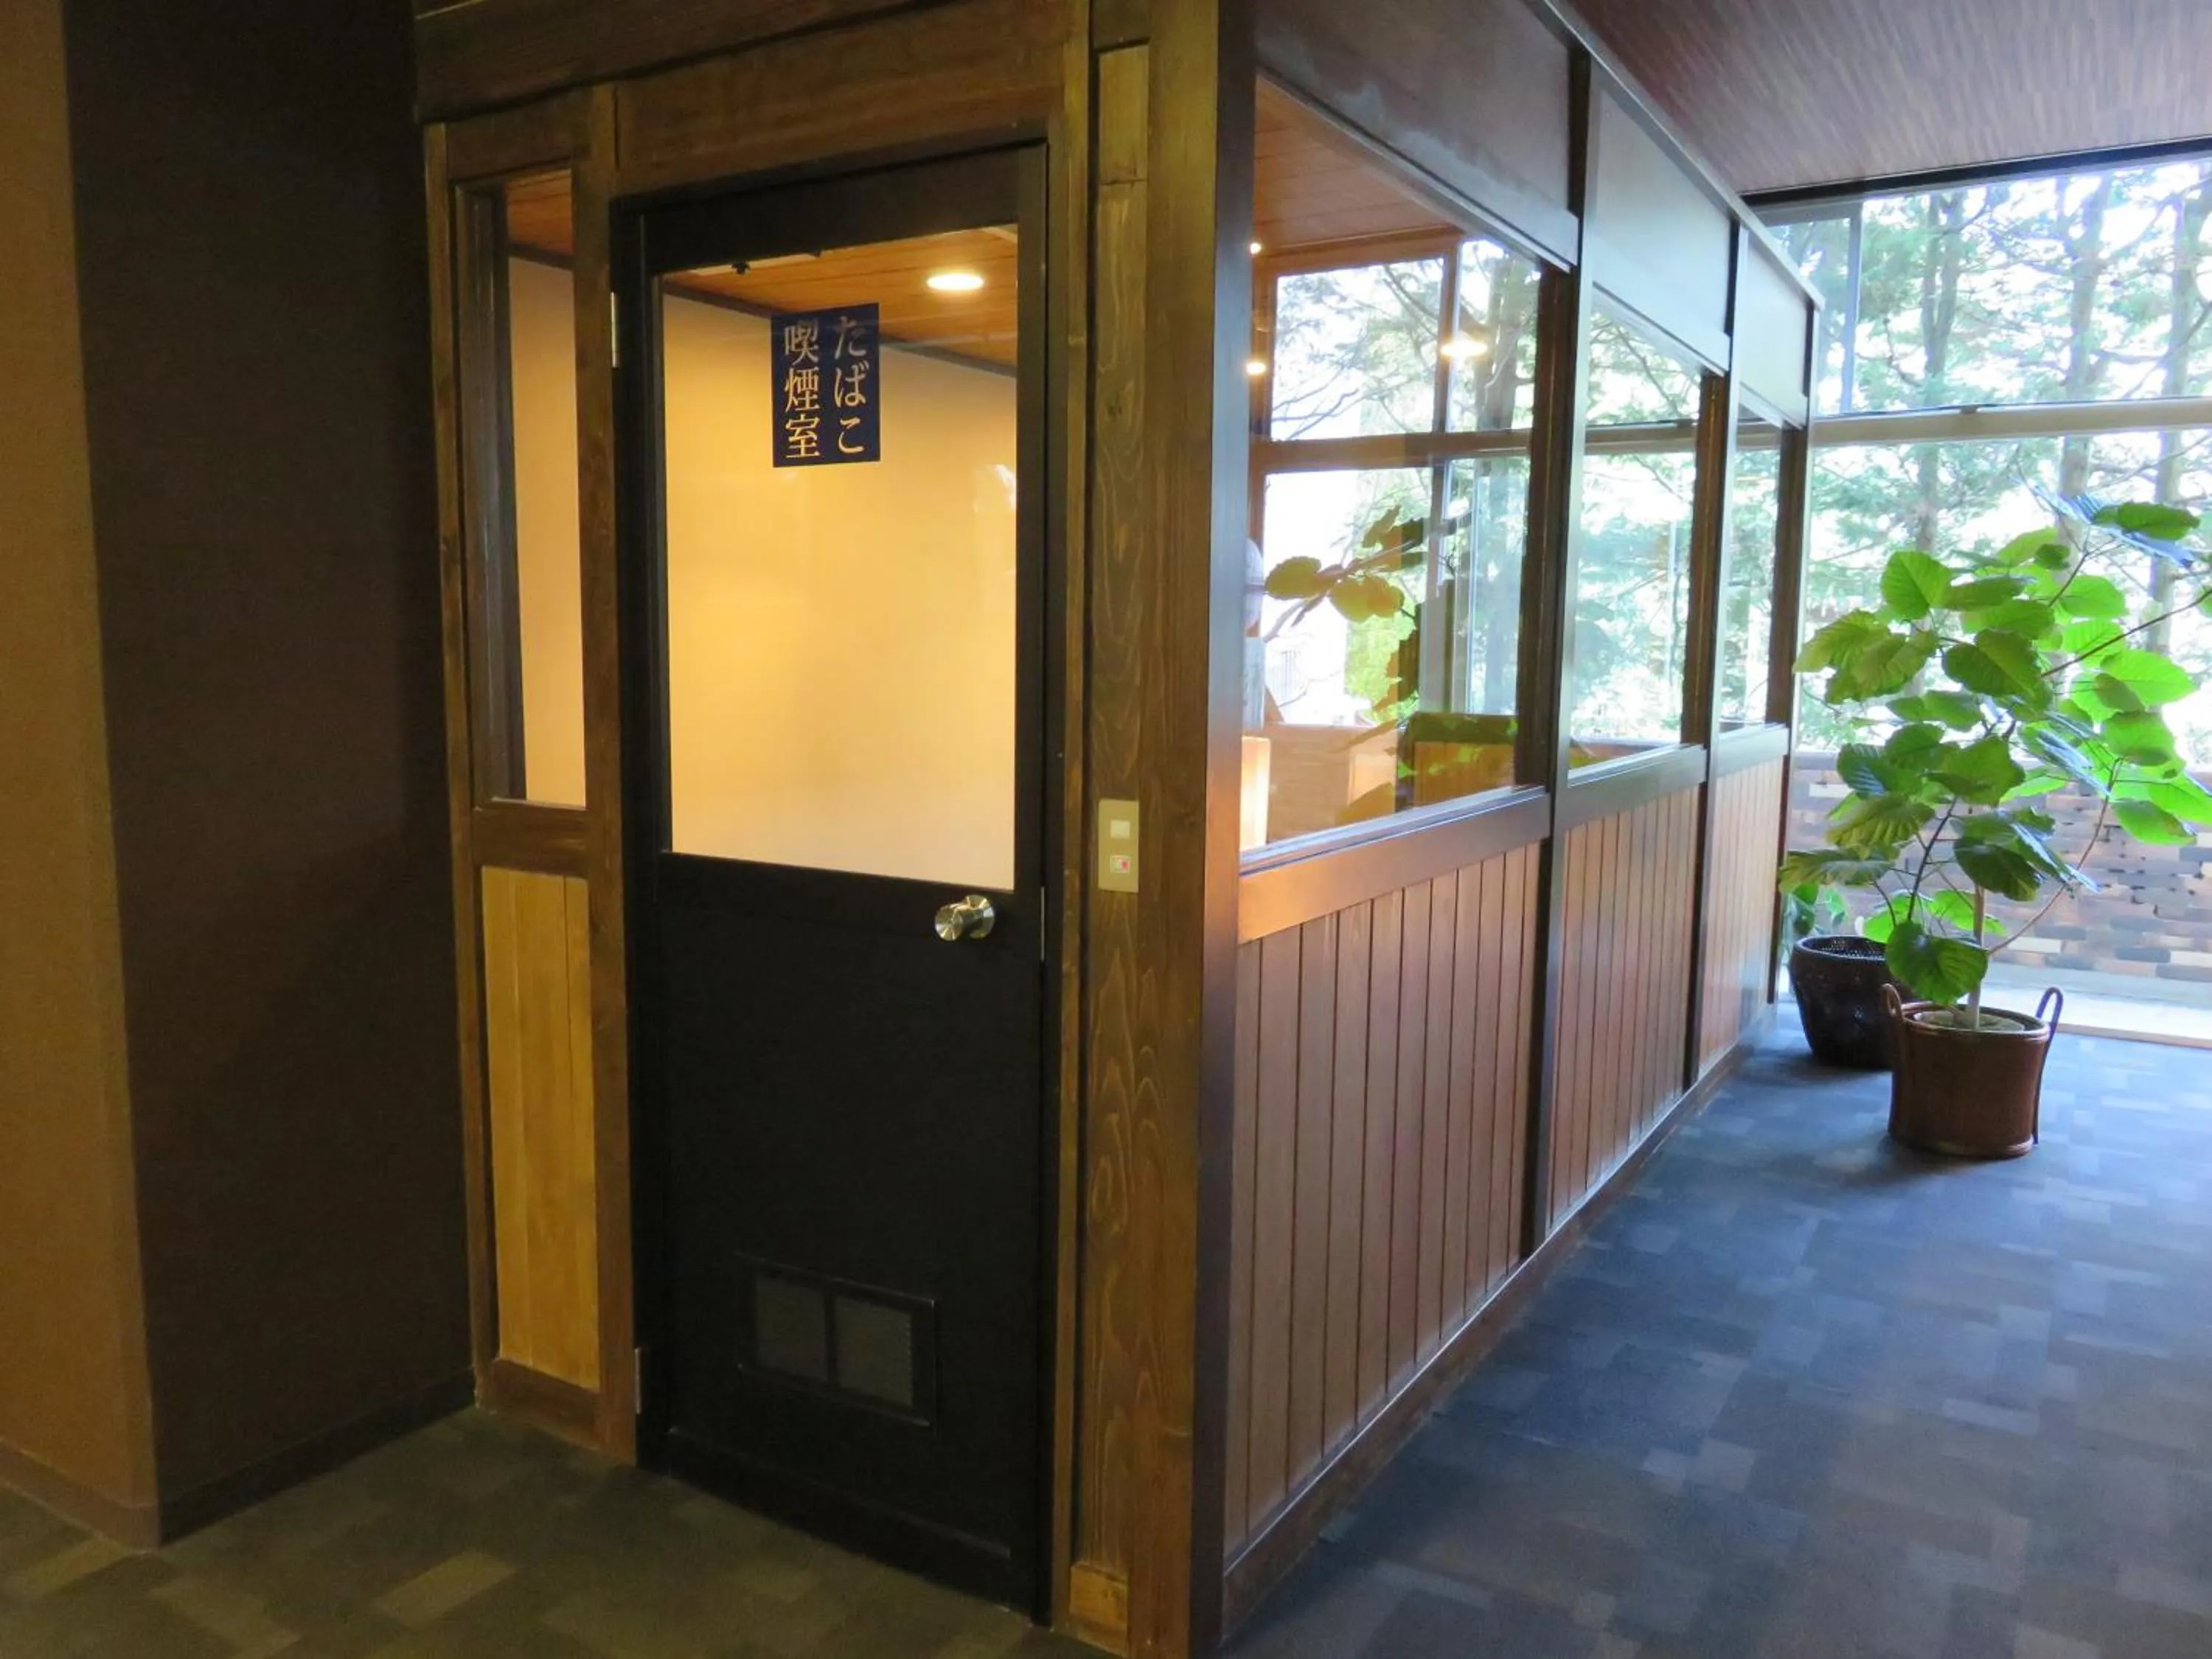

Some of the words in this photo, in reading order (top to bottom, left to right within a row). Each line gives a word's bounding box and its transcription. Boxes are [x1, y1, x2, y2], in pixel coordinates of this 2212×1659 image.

[784, 318, 821, 459] 喫煙室
[834, 316, 870, 453] たばこ
